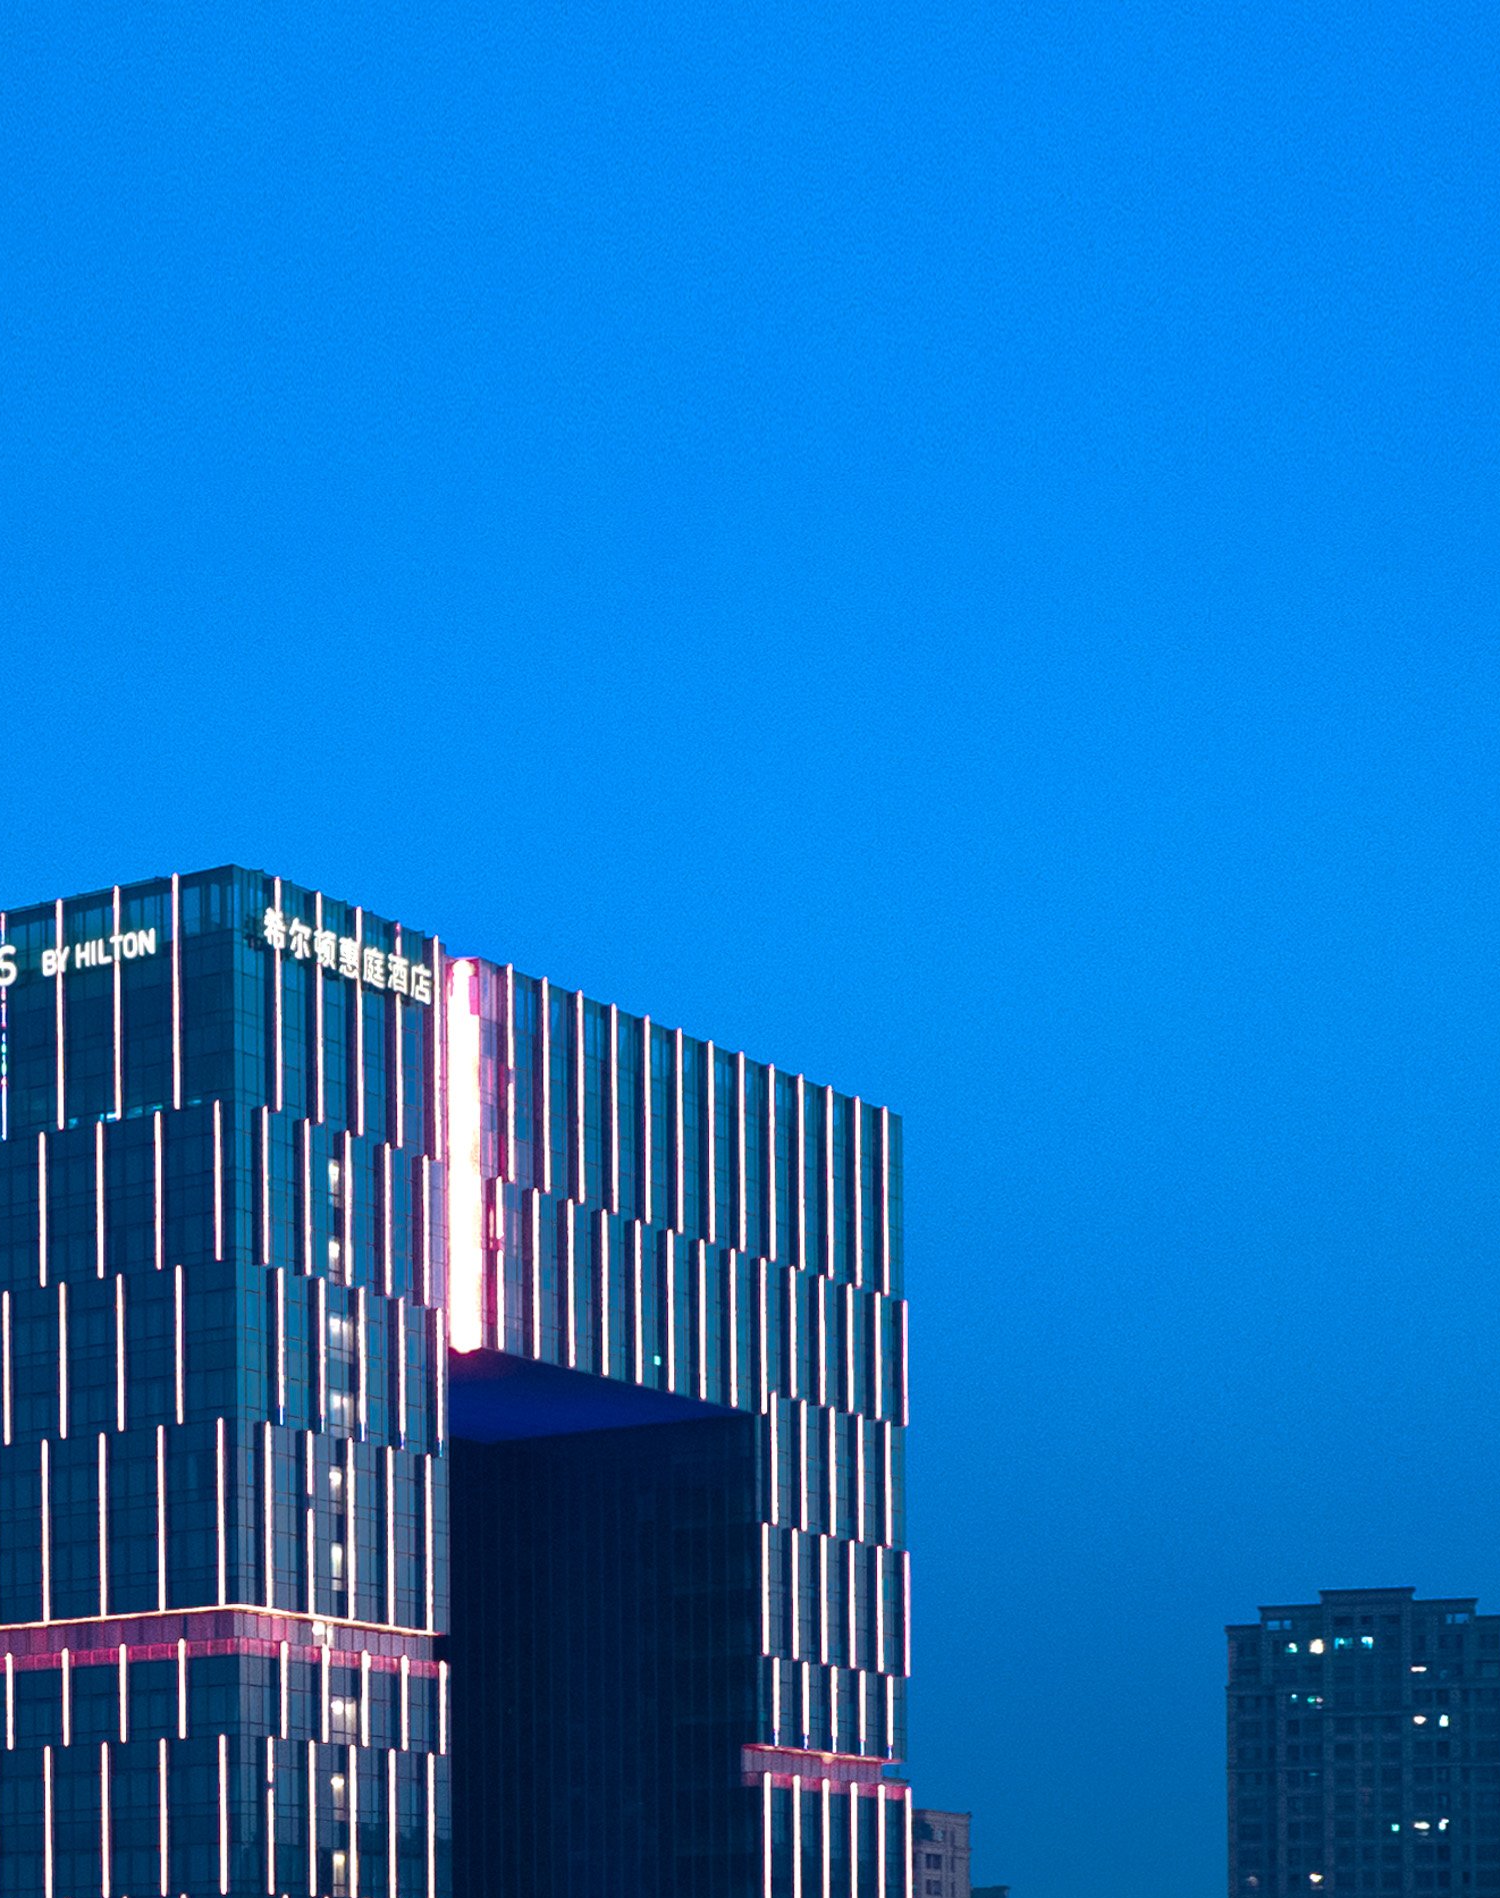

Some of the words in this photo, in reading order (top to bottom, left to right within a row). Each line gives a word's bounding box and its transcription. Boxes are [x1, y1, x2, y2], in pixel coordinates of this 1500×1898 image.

[42, 945, 71, 977] BY
[75, 927, 156, 969] HILTON
[263, 906, 433, 1005] 希尔顿惠庭酒店
